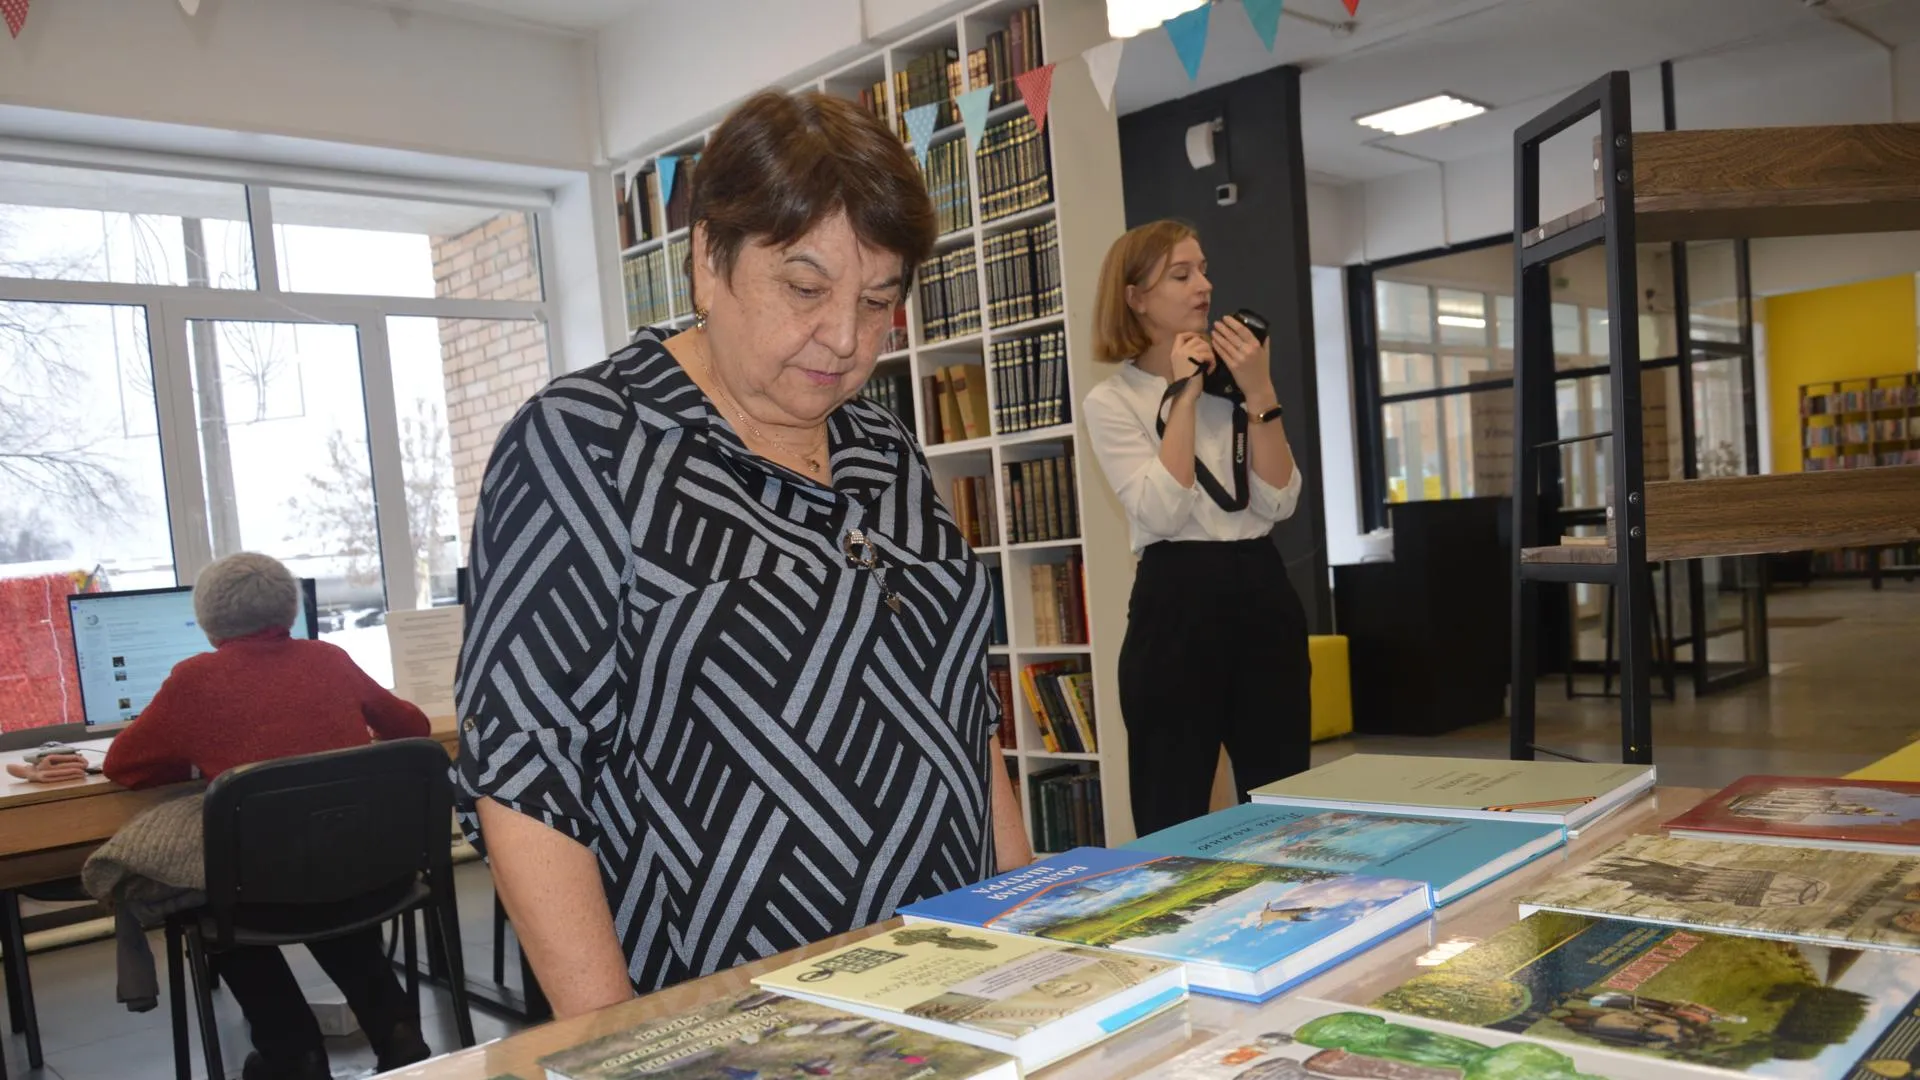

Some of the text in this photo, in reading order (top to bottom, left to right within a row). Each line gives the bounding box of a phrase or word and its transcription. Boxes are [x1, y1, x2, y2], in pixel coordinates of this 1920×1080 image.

[1236, 432, 1244, 464] Canon
[970, 865, 1057, 895] ШАТУРА
[987, 865, 1089, 901] БОЛЬШАЯ
